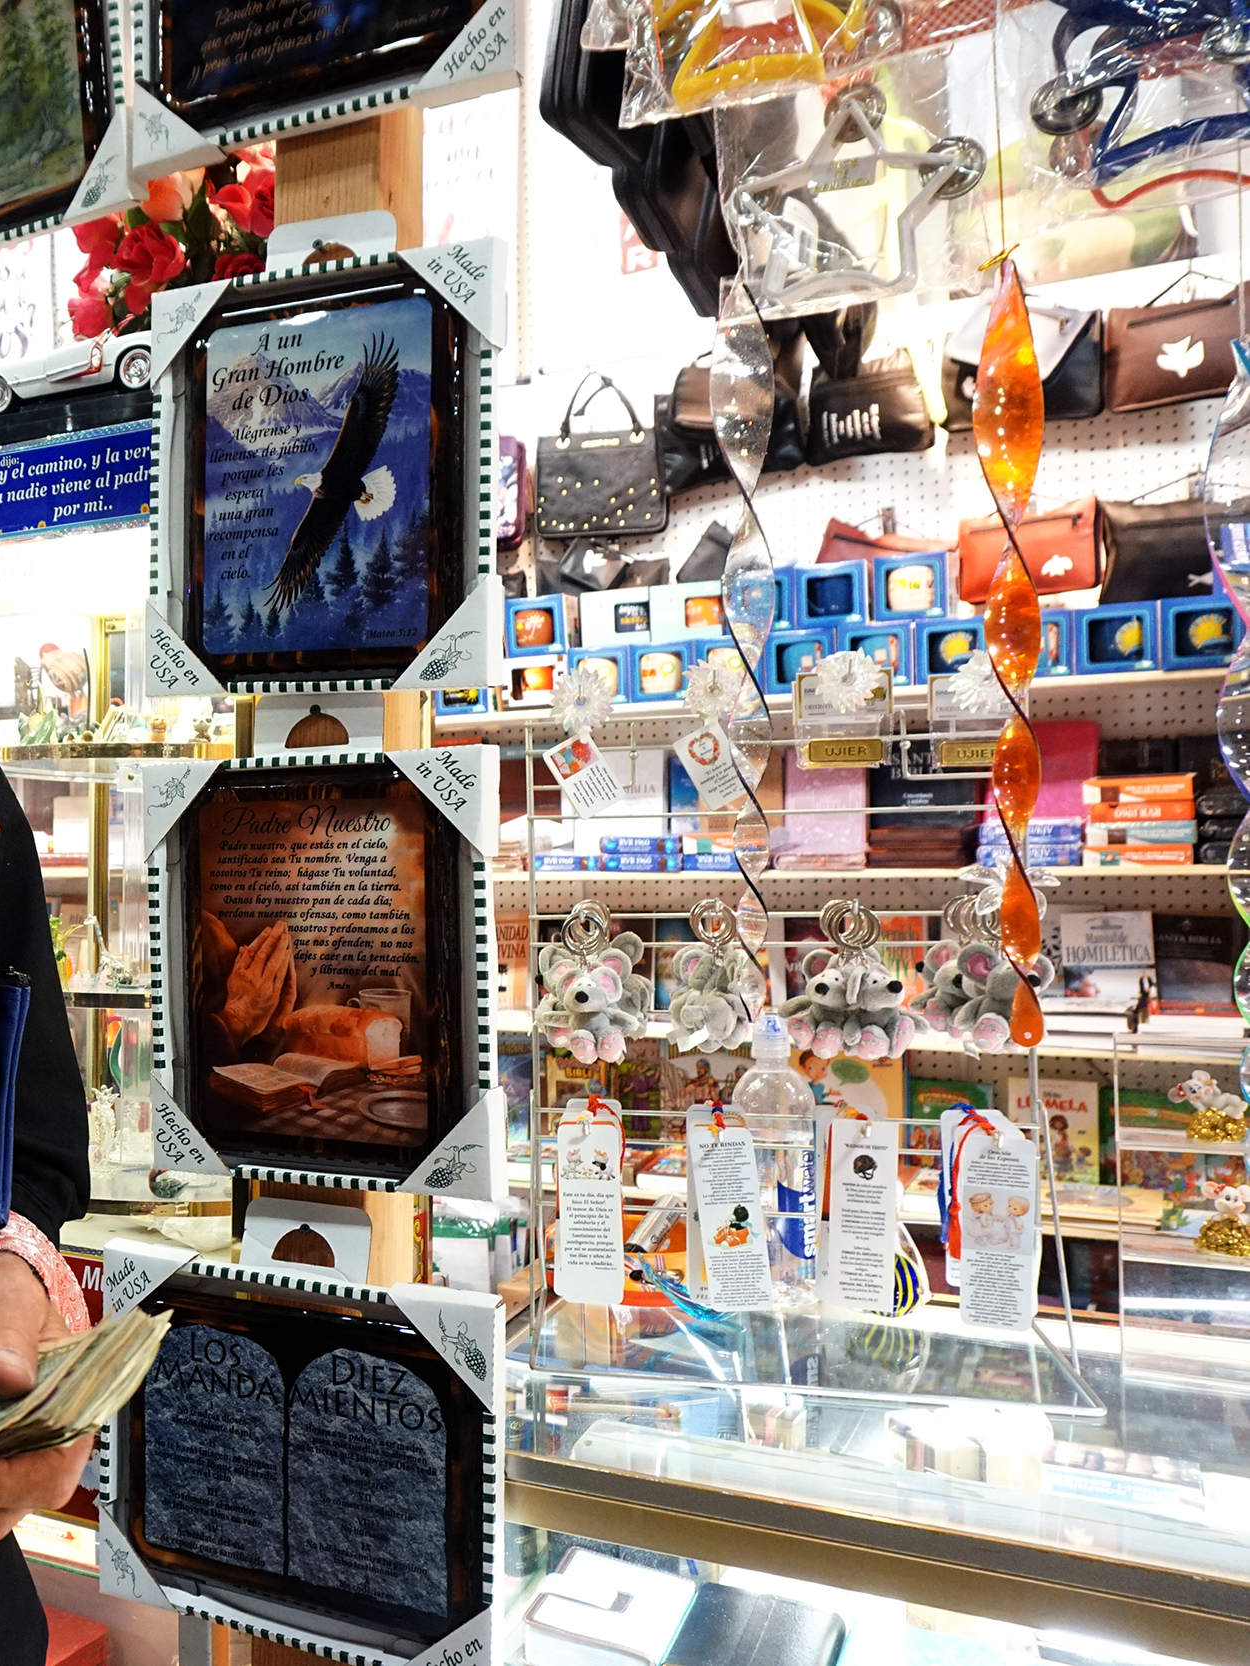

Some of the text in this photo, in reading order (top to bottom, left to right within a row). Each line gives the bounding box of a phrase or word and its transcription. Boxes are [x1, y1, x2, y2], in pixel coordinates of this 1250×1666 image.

[444, 6, 506, 78] Hecho en
[470, 30, 509, 72] USA
[446, 244, 488, 280] Made
[426, 256, 477, 304] in USA
[251, 333, 303, 356] A un
[212, 350, 345, 393] Gran Hombre
[232, 384, 308, 411] de Dios
[228, 424, 302, 443] Alégrense y
[210, 438, 318, 464] llénense de júbilo,
[0, 455, 20, 469] dijo:
[12, 462, 24, 480] el
[28, 456, 88, 476] camino,
[92, 454, 101, 470] y
[105, 448, 120, 464] la
[124, 446, 151, 461] ver
[221, 462, 284, 486] porque les
[6, 482, 48, 502] nadie
[51, 478, 92, 496] viene
[96, 471, 110, 488] al
[114, 466, 152, 490] padr
[225, 488, 264, 504] espera
[52, 504, 80, 522] por
[218, 507, 274, 524] una gran
[209, 526, 279, 543] recompensa
[221, 544, 252, 560] en el
[220, 564, 250, 580] cielo.
[366, 628, 418, 638] Mateo 5:12
[150, 628, 200, 686] Hecho en
[150, 654, 179, 690] USA
[824, 746, 868, 757] UJIER
[435, 750, 477, 790] Made
[416, 760, 468, 813] in USA
[222, 804, 390, 838] Padre Nuestro
[220, 840, 248, 850] Padre
[250, 842, 287, 852] nuestro,
[290, 843, 308, 852] que
[310, 840, 334, 850] estás
[351, 838, 362, 848] el
[363, 838, 388, 850] cielo,
[636, 836, 651, 846] 1960
[217, 854, 268, 866] santificado
[271, 856, 286, 864] sea
[288, 854, 302, 864] Tu
[304, 853, 342, 864] nombre.
[346, 853, 378, 866] Venga
[210, 866, 396, 880] nosotros Tu reino; hágase Tu voluntad,
[210, 883, 232, 891] como
[235, 883, 245, 891] en
[248, 880, 258, 890] el
[259, 880, 282, 892] cielo,
[286, 882, 300, 891] así
[302, 880, 340, 891] también
[358, 880, 368, 891] la
[371, 882, 402, 891] tierra.
[224, 894, 392, 908] Danos hoy nuestro pan de cada día;
[218, 908, 410, 921] perdona nuestras ofensas, como también
[288, 924, 328, 933] nosotros
[329, 922, 389, 936] perdonamos
[400, 923, 416, 934] los
[294, 939, 310, 948] que
[313, 938, 330, 946] nos
[332, 936, 374, 950] ofenden;
[498, 944, 526, 959] IVINA
[294, 950, 318, 963] dejes
[320, 952, 340, 960] caer
[357, 951, 367, 962] la
[370, 952, 420, 964] tentación,
[310, 964, 401, 977] y líbranos del mal.
[327, 981, 351, 990] Amén
[155, 1103, 206, 1164] Hecho en
[156, 1128, 185, 1165] USA
[799, 1150, 816, 1259] smartwate
[106, 1258, 136, 1292] Made
[111, 1270, 152, 1312] in USA
[190, 1332, 408, 1398] LOS DIEZ
[154, 1356, 442, 1434] MANDA MIENTOS
[464, 1638, 483, 1657] en
